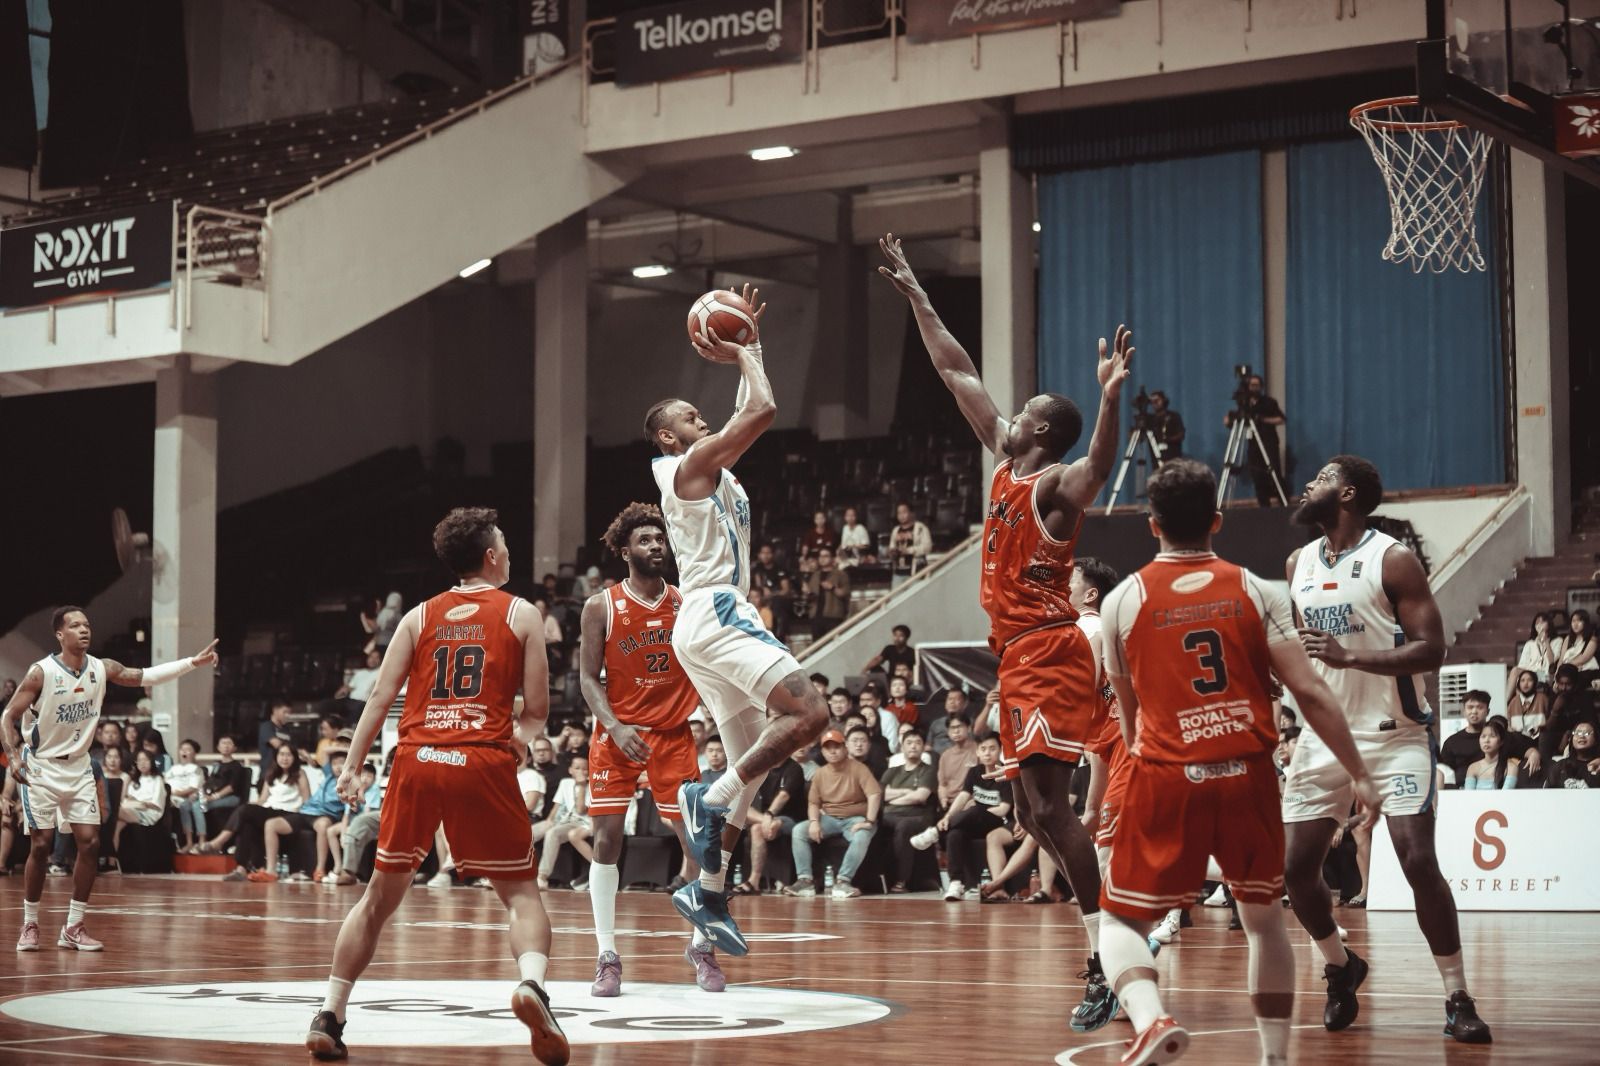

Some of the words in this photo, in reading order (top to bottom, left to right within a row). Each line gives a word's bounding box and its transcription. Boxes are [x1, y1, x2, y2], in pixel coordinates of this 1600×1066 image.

[634, 0, 782, 51] Telkomsel
[34, 217, 136, 273] ROXIT
[67, 267, 100, 288] GYM
[1303, 603, 1353, 622] SATRIA
[1307, 615, 1349, 631] MUDA
[435, 624, 486, 641] DARRYL
[1326, 623, 1366, 637] TAMINA
[619, 629, 673, 656] RAJAWA
[430, 644, 487, 700] 18
[645, 652, 670, 675] 22
[1181, 628, 1229, 697] 3
[424, 719, 469, 730] SPORTS
[425, 709, 462, 720] ROYAL
[1179, 709, 1230, 731] ROYAL
[1182, 720, 1244, 744] SPORTS
[1391, 774, 1419, 797] 35
